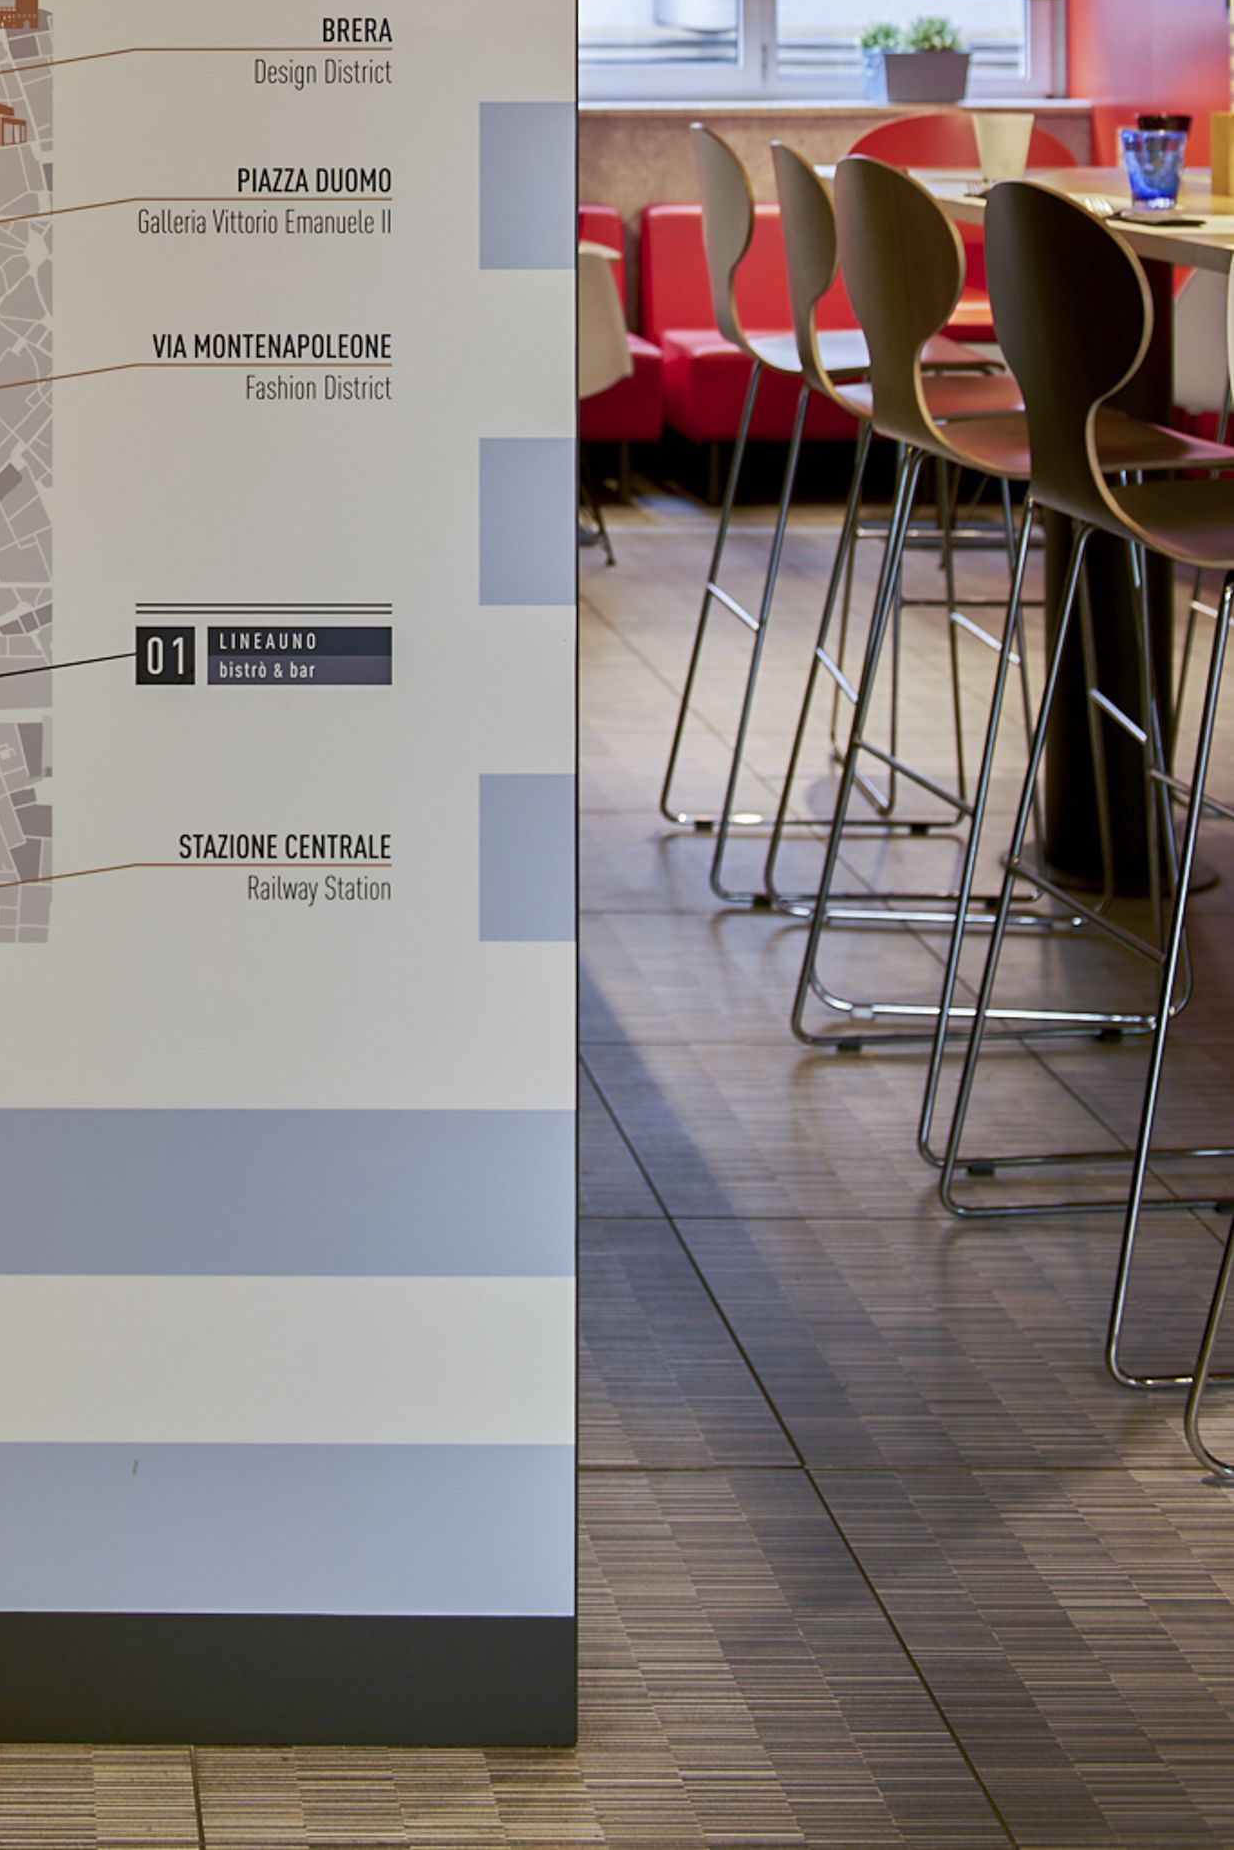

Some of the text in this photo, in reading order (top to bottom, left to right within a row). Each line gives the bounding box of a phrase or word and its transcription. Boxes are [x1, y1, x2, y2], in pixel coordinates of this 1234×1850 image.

[323, 18, 392, 42] BRERA
[255, 59, 392, 91] Design District
[238, 168, 391, 193] PIAZZA DUOMO
[139, 209, 391, 234] Galleria Vittorio Emanuele II
[152, 334, 391, 358] VIA MONTENAPOLEONE
[247, 375, 392, 400] Fashion District
[148, 637, 183, 675] 01
[220, 661, 315, 678] bistrò & bar
[179, 834, 391, 859] STAZIONE CENTRALE
[248, 875, 391, 907] Railway Station
